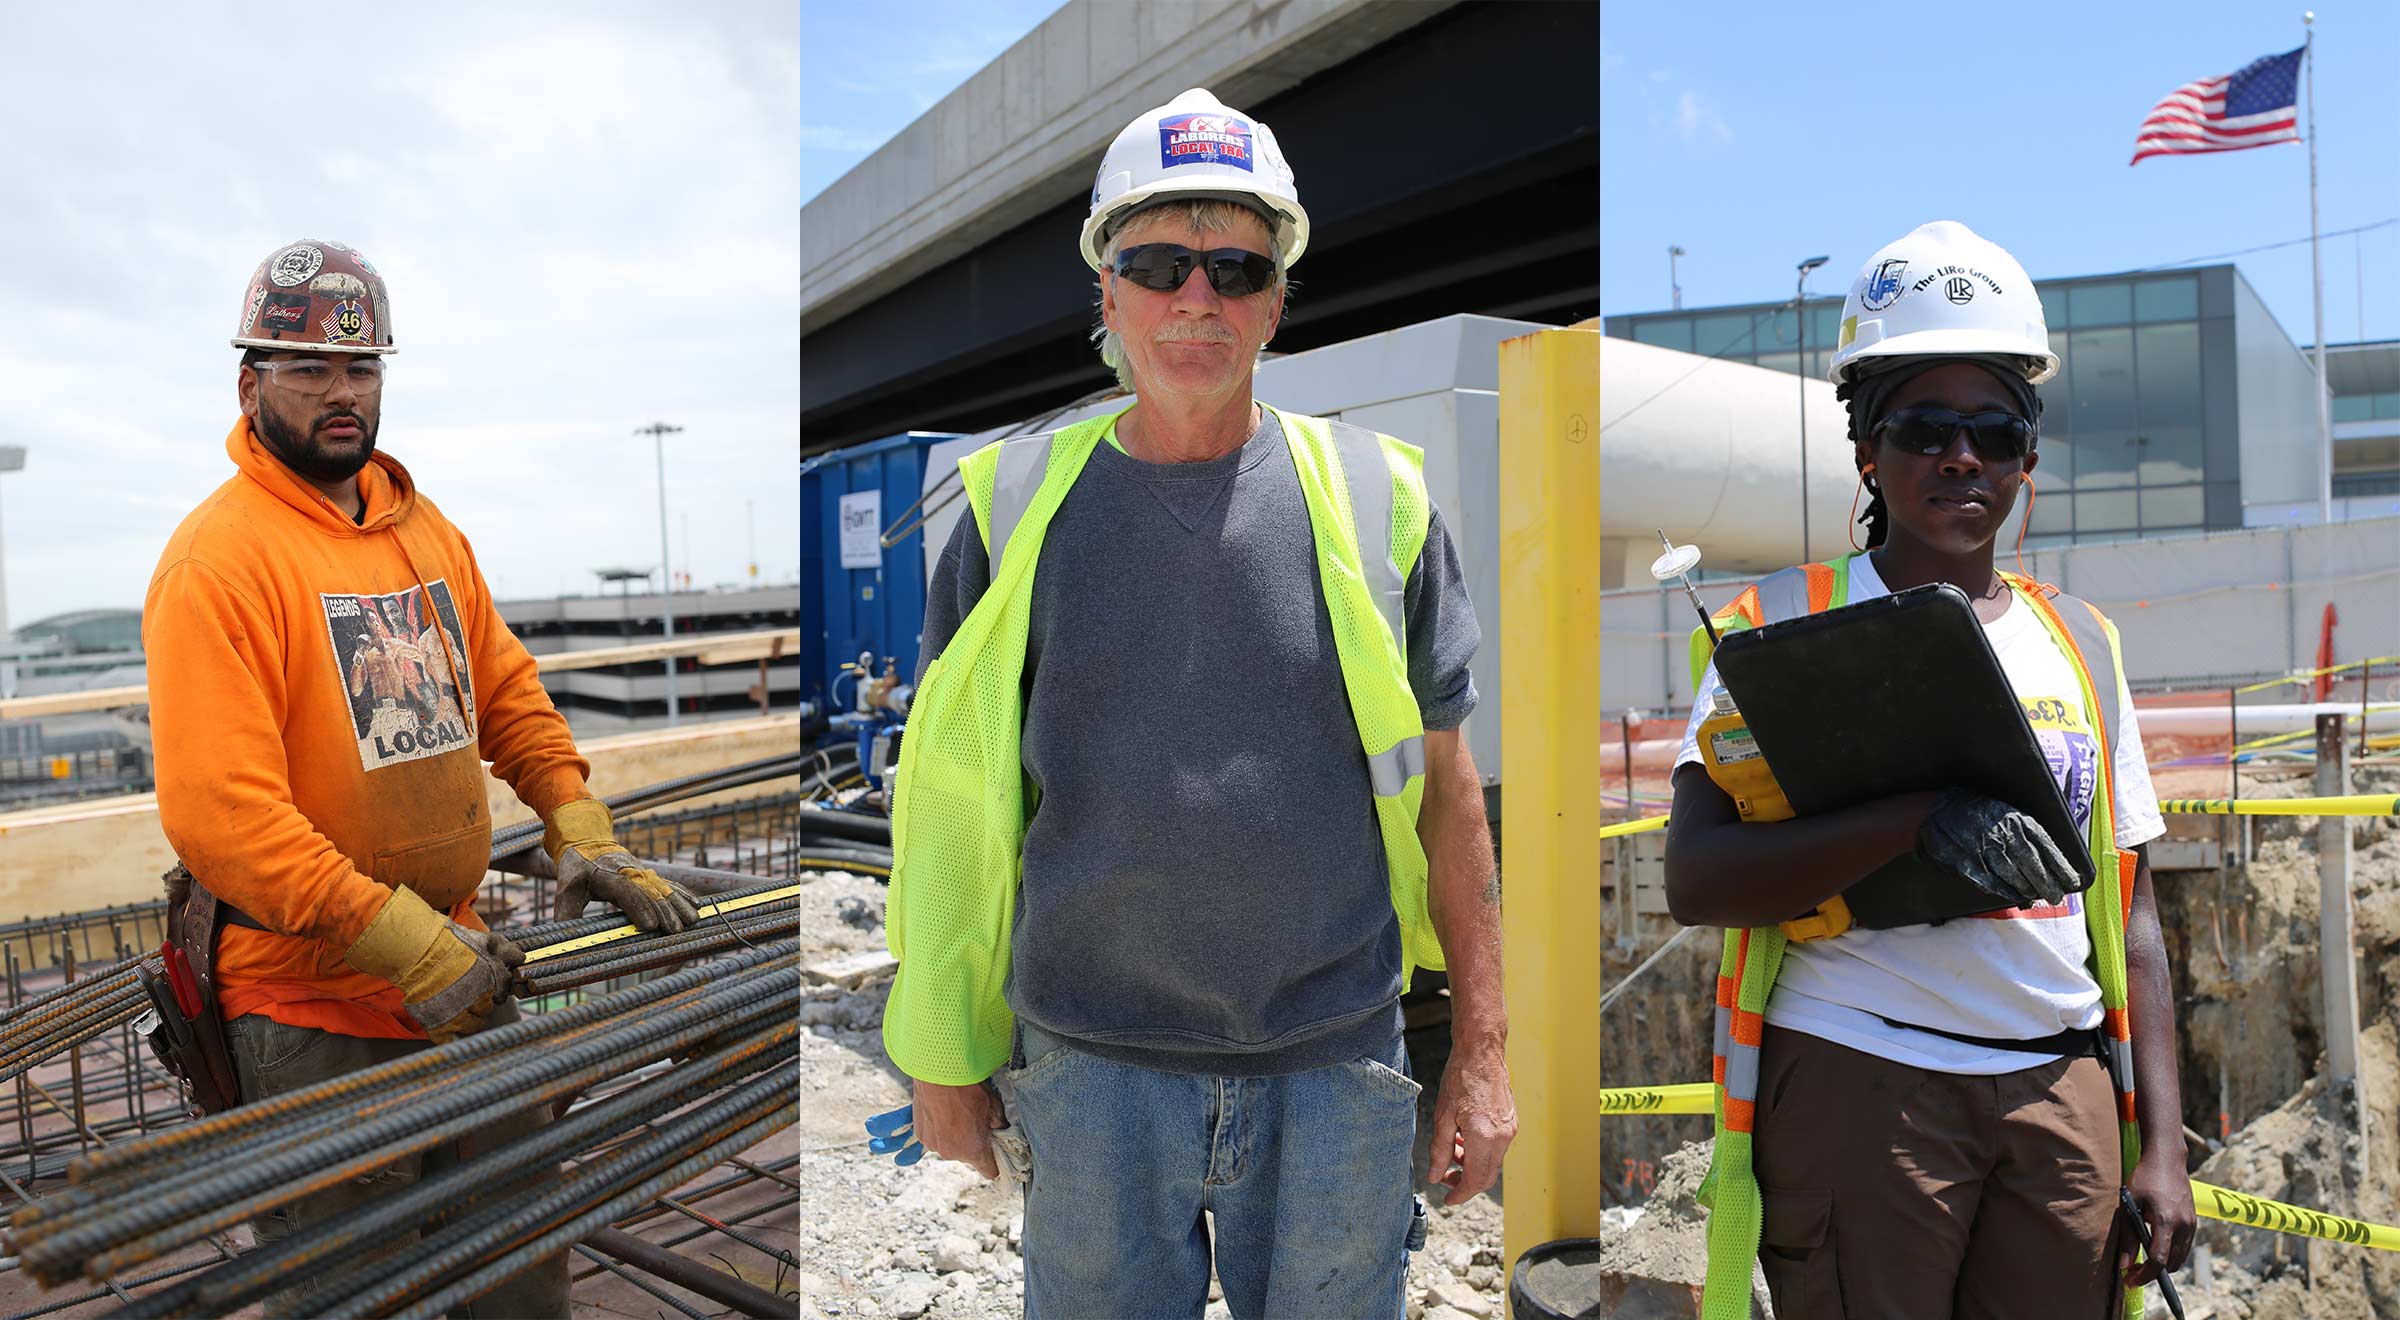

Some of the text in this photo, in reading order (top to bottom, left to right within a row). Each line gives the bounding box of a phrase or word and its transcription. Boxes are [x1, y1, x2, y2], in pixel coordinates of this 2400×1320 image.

[1170, 131, 1245, 148] LABORERS
[1171, 142, 1217, 156] LOCAL
[1220, 144, 1245, 160] 18A
[1912, 273, 1937, 293] The
[1969, 267, 2003, 295] Group
[244, 287, 265, 331] SUCKS
[340, 312, 360, 329] 46
[326, 598, 361, 617] LEGENDS
[374, 719, 465, 760] LOCAL
